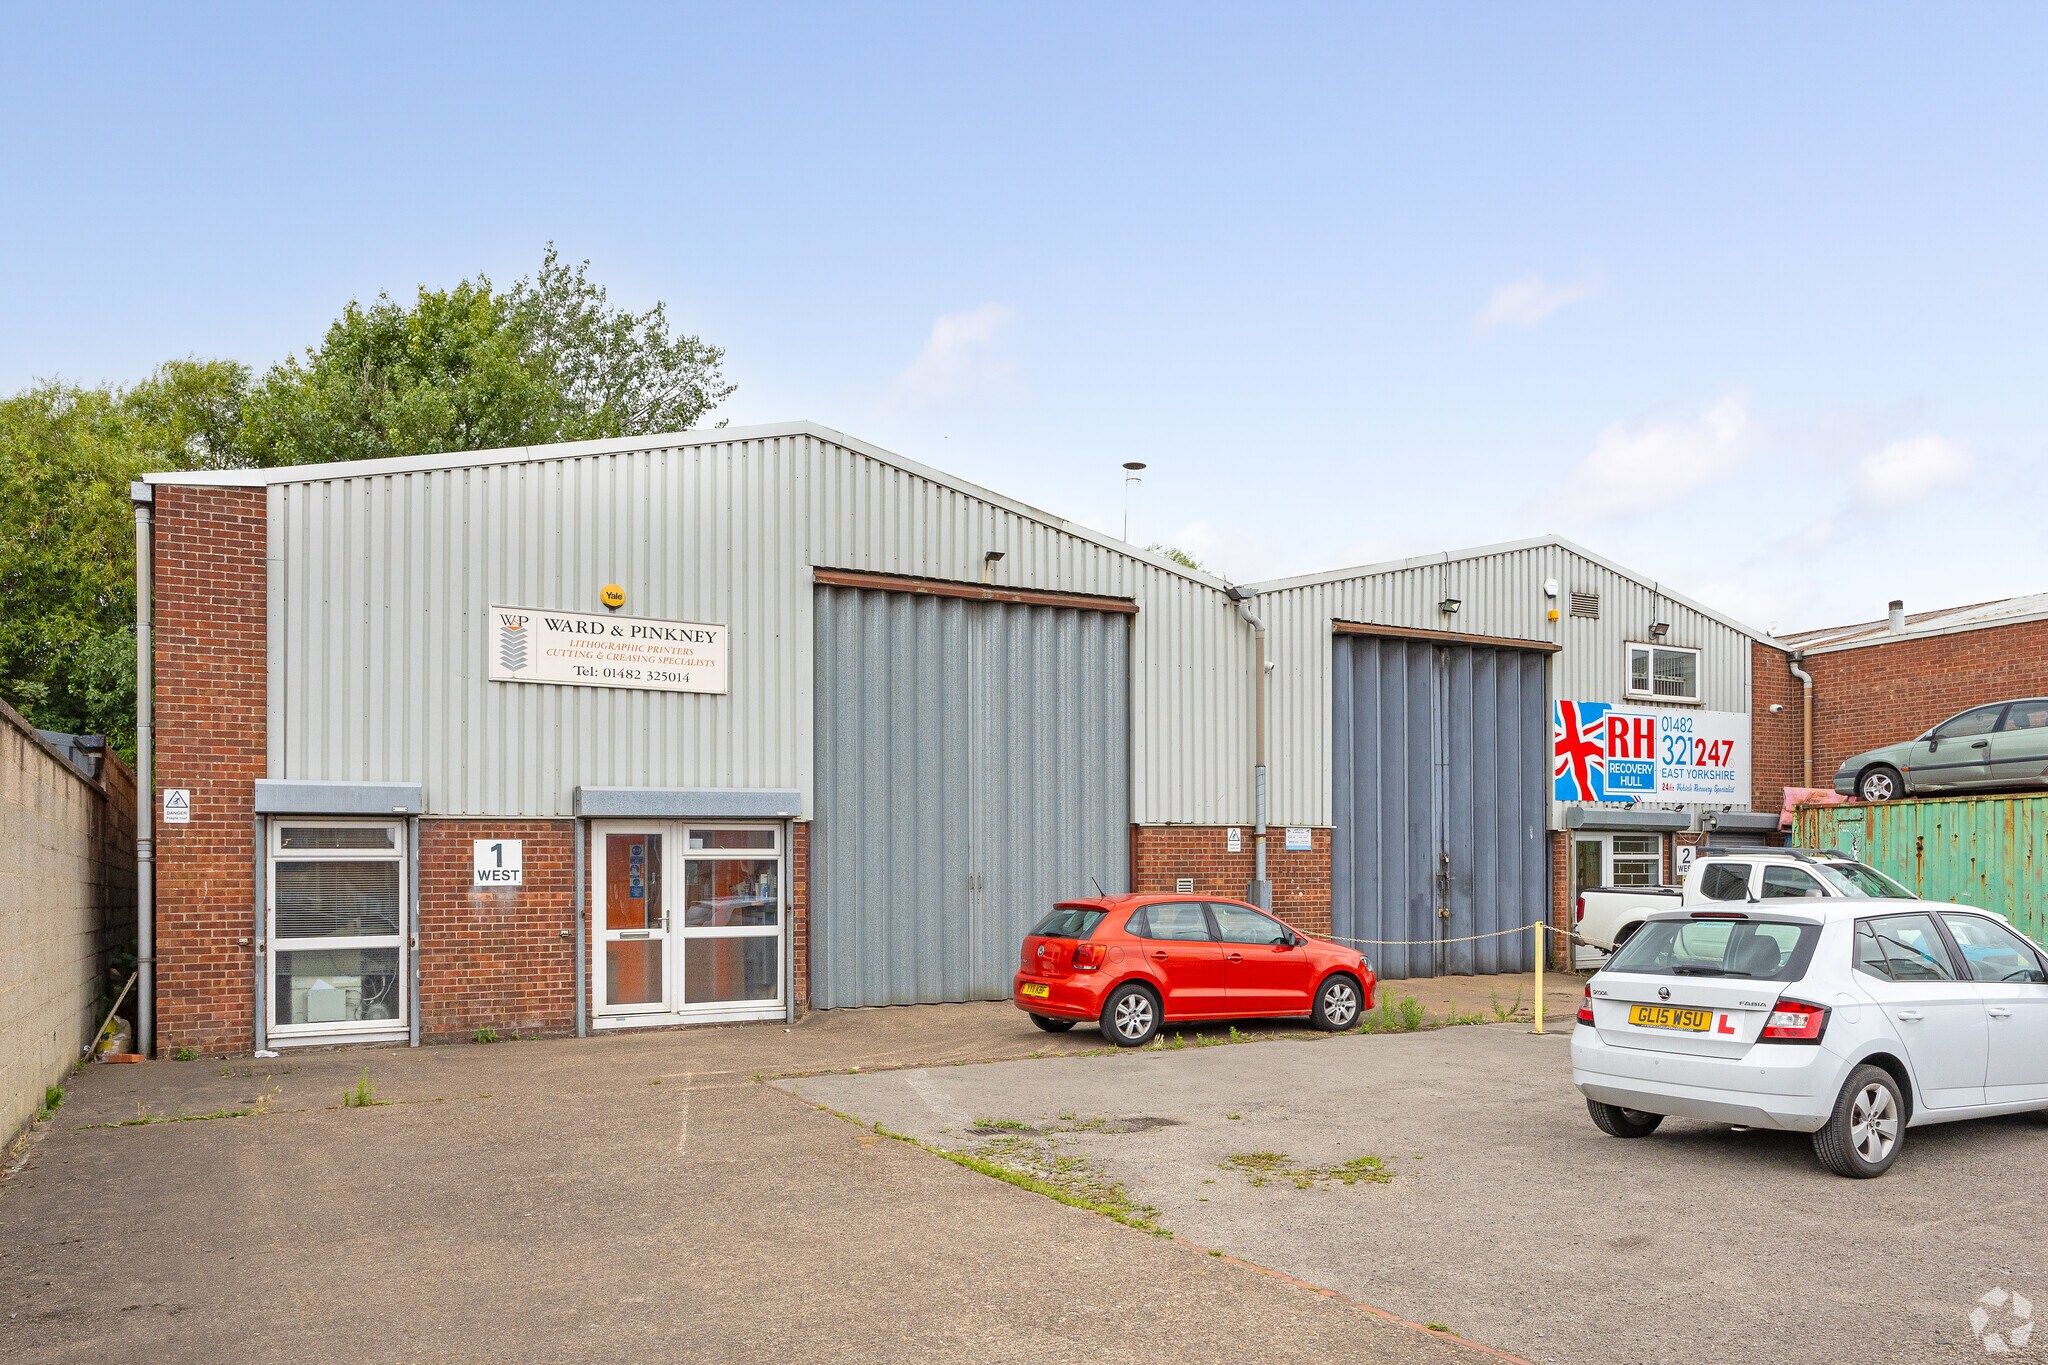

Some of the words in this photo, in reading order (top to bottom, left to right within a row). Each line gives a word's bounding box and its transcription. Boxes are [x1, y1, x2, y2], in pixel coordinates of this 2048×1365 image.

[606, 591, 623, 601] Yale
[544, 617, 605, 635] WARD
[610, 624, 624, 637] &
[630, 624, 717, 644] PINKNEY
[569, 639, 644, 653] LITHOGRAPHIC
[646, 645, 694, 656] PRINTERS
[546, 648, 593, 659] CUTTING
[596, 651, 604, 660] &
[606, 652, 655, 664] CREASING
[658, 656, 716, 668] SPECIALISTS
[572, 665, 598, 677] Tel:
[603, 667, 641, 680] 01482
[646, 670, 690, 682] 325014
[1661, 716, 1693, 733] 01482
[1607, 716, 1655, 759] RH
[1609, 762, 1653, 775] RECOVERY
[1661, 767, 1684, 779] EAST
[1687, 769, 1735, 781] YORKSHIRE
[1620, 775, 1643, 787] HULL
[1694, 784, 1713, 796] Recovery
[490, 843, 503, 868] 1
[1682, 847, 1691, 864] 2
[477, 869, 520, 882] WEST
[1678, 864, 1691, 873] WES
[1739, 1000, 1767, 1008] FABIA
[1638, 1007, 1670, 1024] GL15
[1672, 1010, 1704, 1028] WSU
[1718, 1014, 1735, 1035] L
